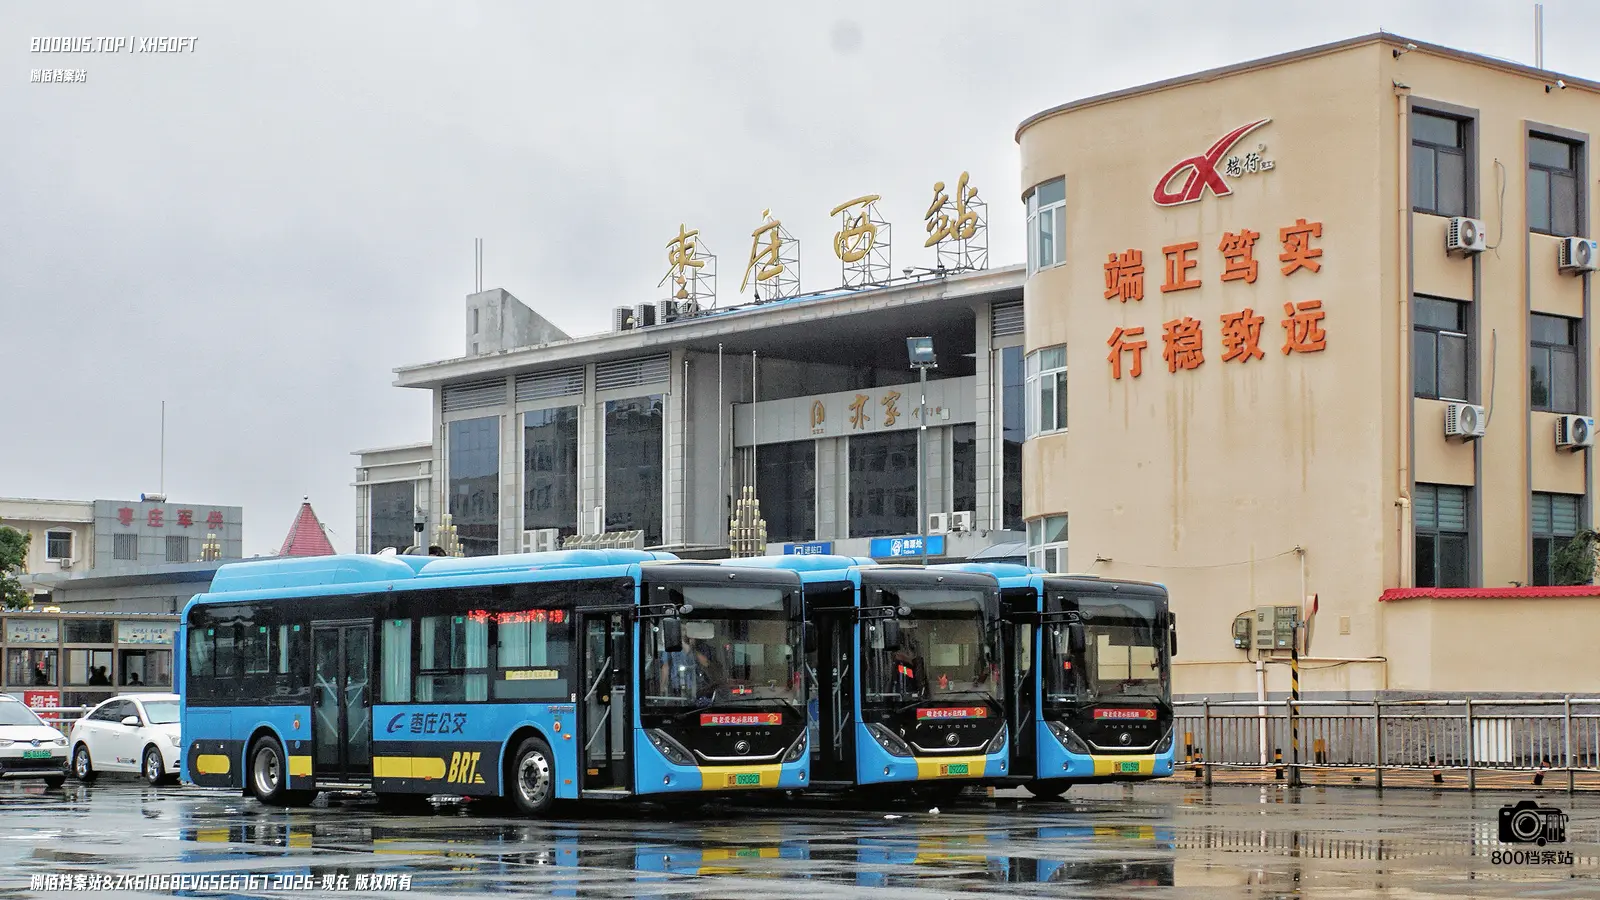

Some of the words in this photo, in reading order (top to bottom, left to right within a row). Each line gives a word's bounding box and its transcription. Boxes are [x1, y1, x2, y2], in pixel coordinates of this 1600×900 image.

[1104, 218, 1323, 304] 端正笃实
[1106, 299, 1327, 379] 行稳致远
[410, 711, 468, 735] 枣庄公交
[447, 751, 482, 785] BRT
